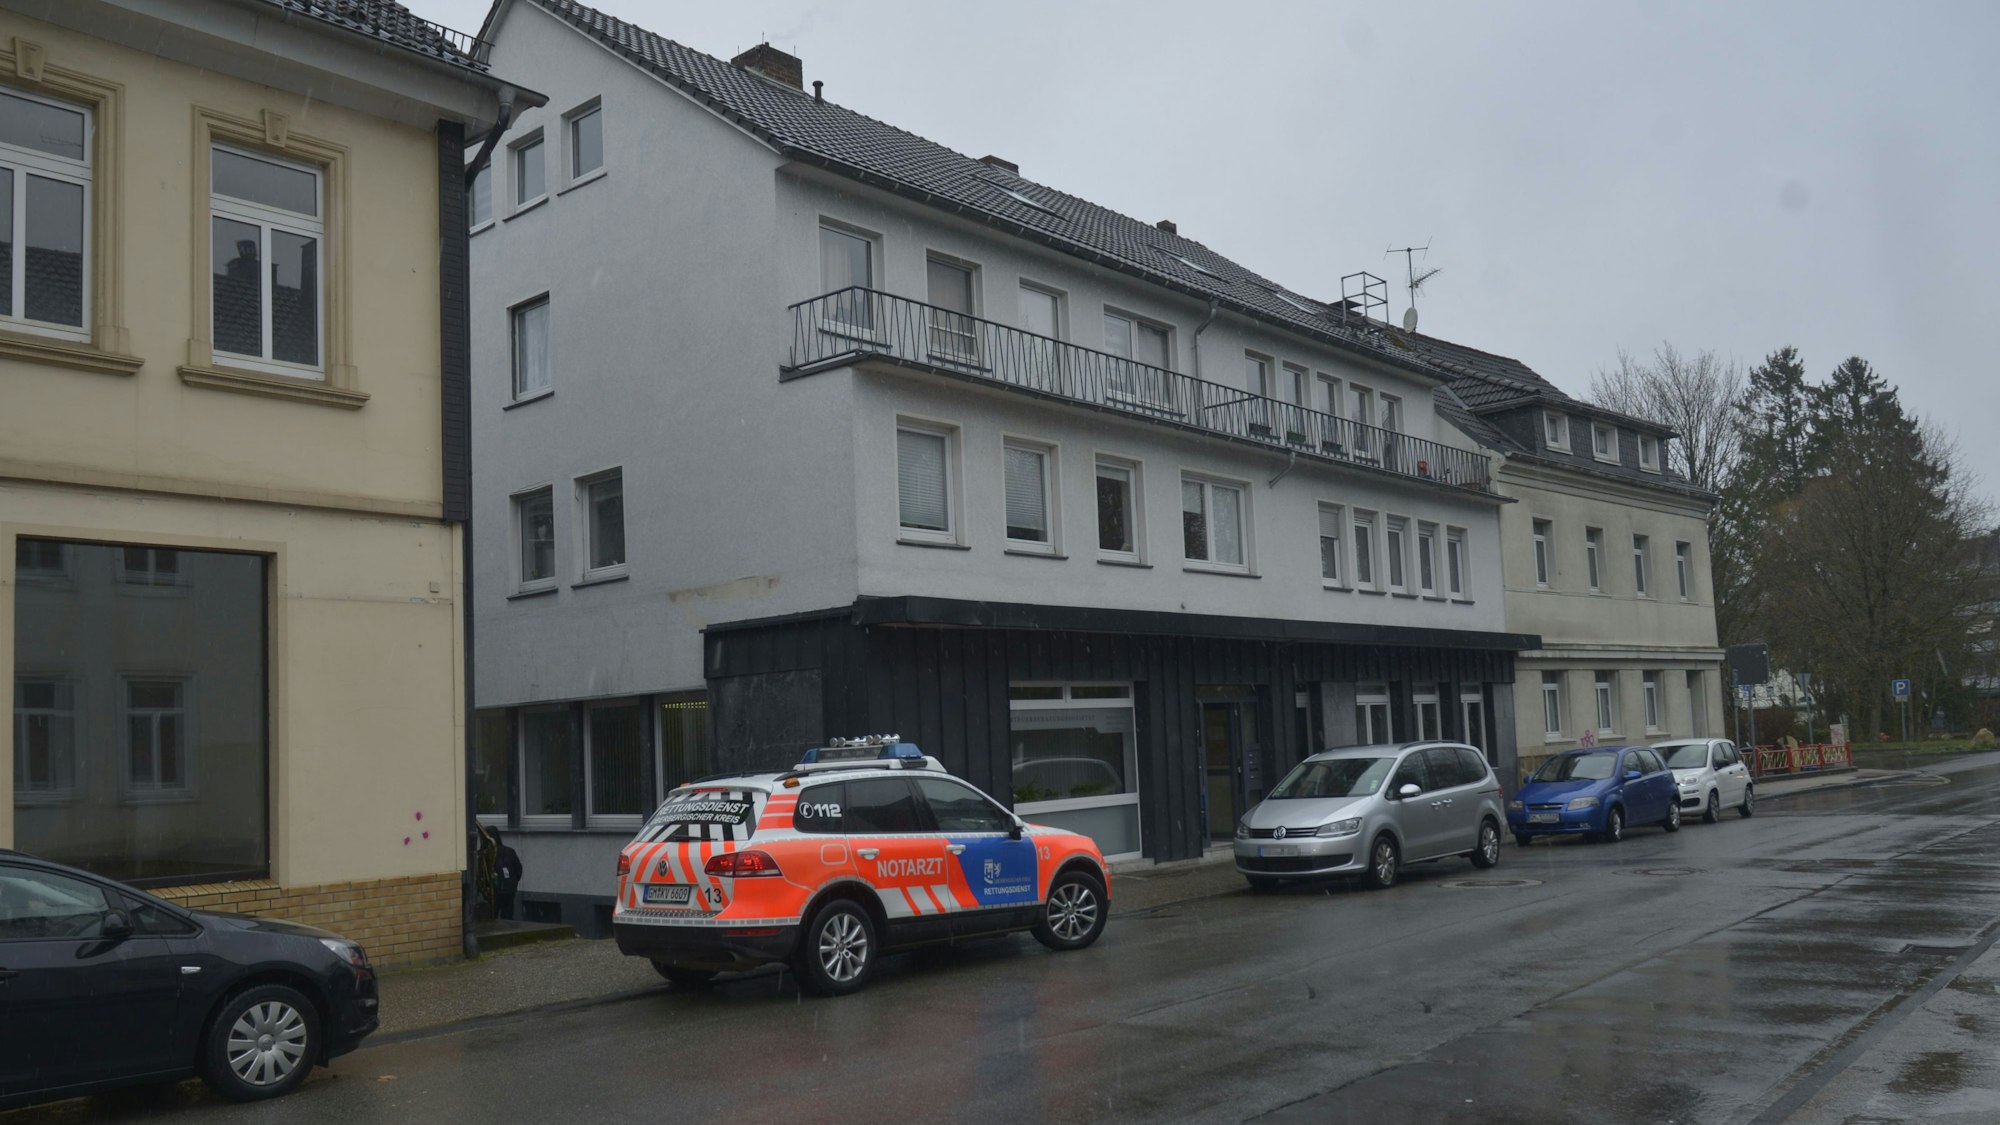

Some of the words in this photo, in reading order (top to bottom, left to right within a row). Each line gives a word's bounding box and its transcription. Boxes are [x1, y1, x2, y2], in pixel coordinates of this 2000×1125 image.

[1896, 681, 1906, 694] P
[658, 802, 749, 815] RETTUNGSDIENST
[814, 804, 842, 818] 112
[713, 814, 741, 824] KREIS
[1038, 846, 1051, 861] 13
[877, 858, 943, 878] NOTARZT
[670, 888, 688, 899] 6609
[704, 888, 722, 904] 13
[984, 885, 1031, 895] RETTUNGSDIENST
